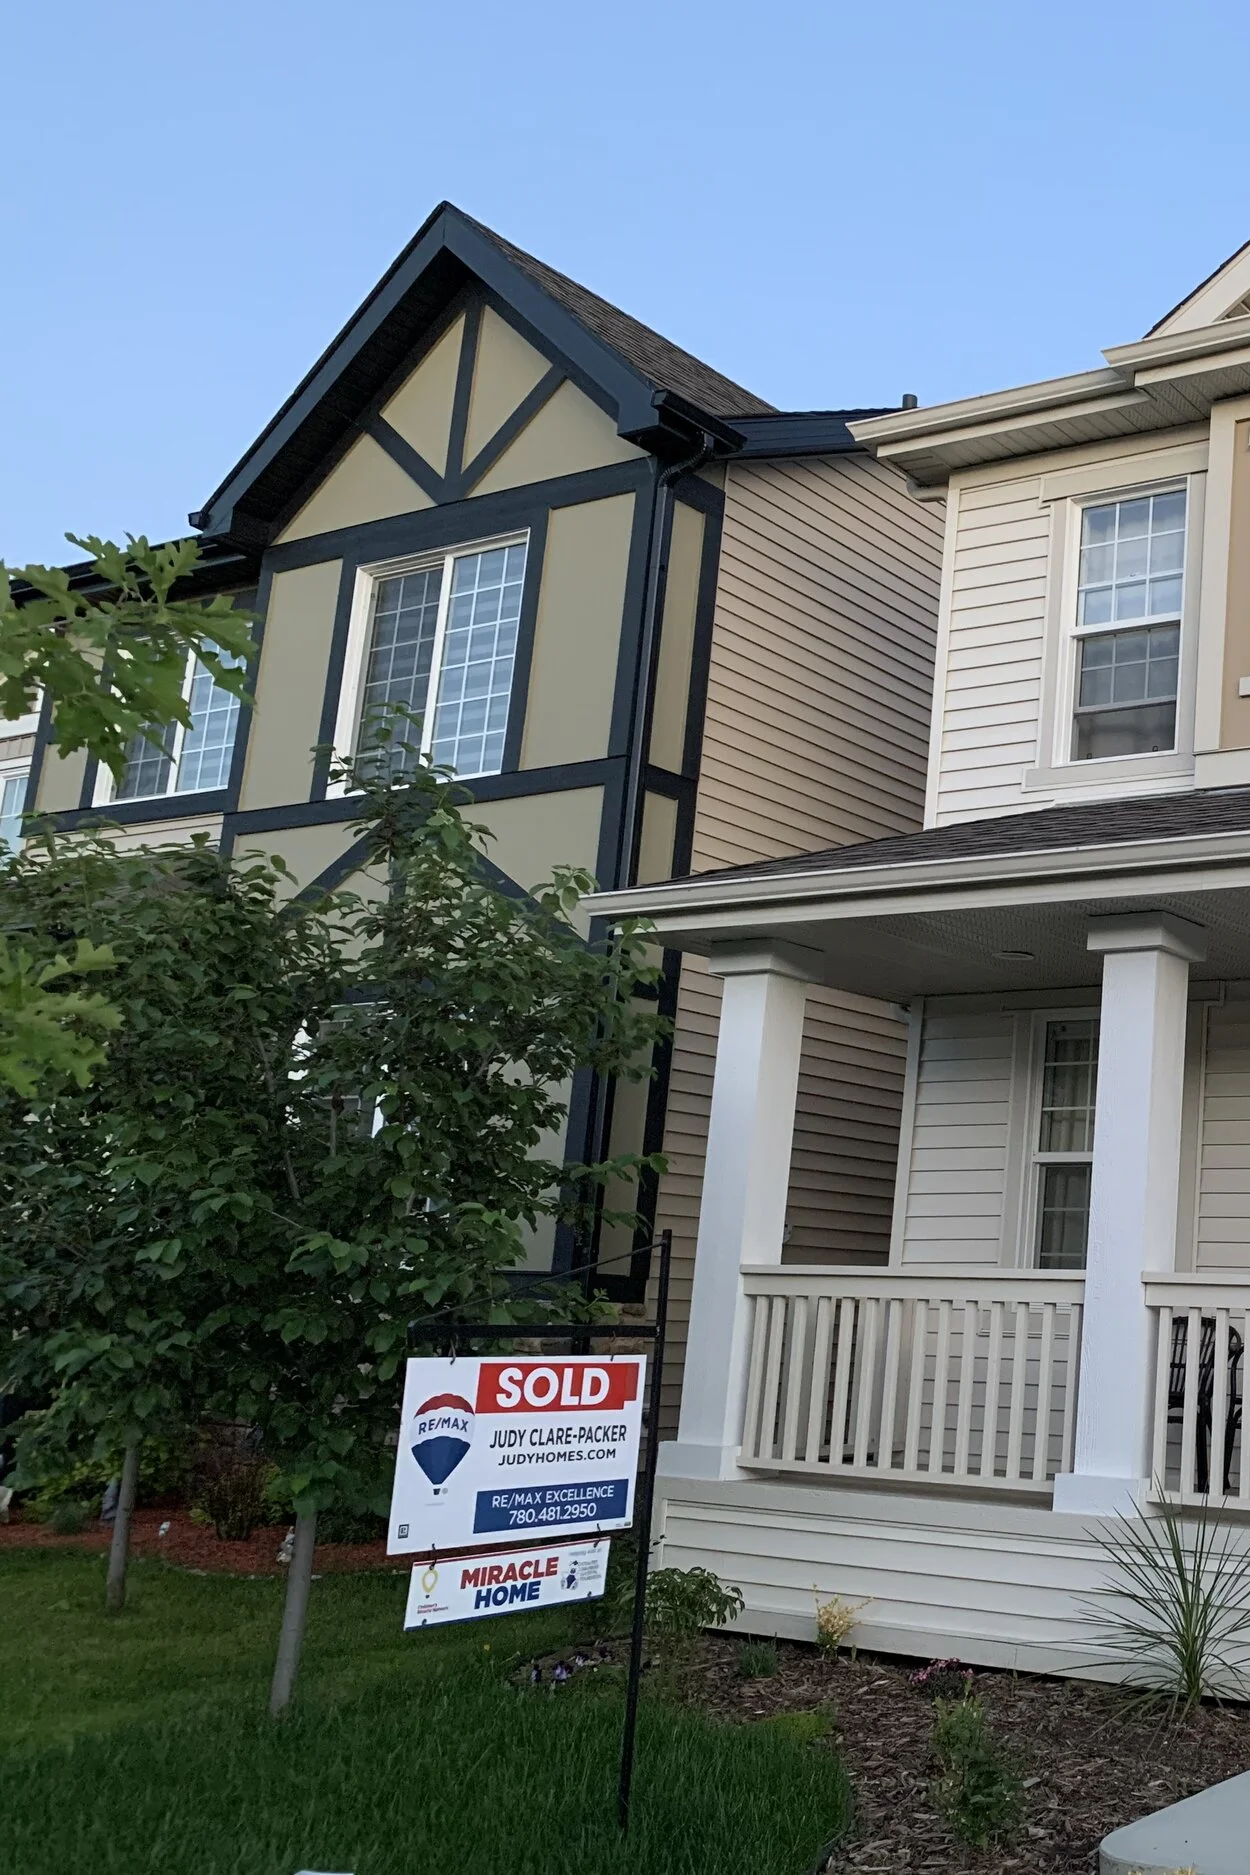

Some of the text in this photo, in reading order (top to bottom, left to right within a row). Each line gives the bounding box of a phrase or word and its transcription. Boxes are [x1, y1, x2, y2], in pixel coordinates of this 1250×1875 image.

[496, 1367, 610, 1409] SOLD
[418, 1416, 469, 1435] RE/MAX
[489, 1424, 627, 1449] JUDY CLARE-PACKER
[498, 1448, 616, 1466] JUDYHOMES.COM
[492, 1485, 614, 1509] RE/MAX EXCELLENCE
[508, 1503, 597, 1526] 780.481.2950
[460, 1556, 560, 1590] MIRACLE
[474, 1581, 541, 1610] HOME
